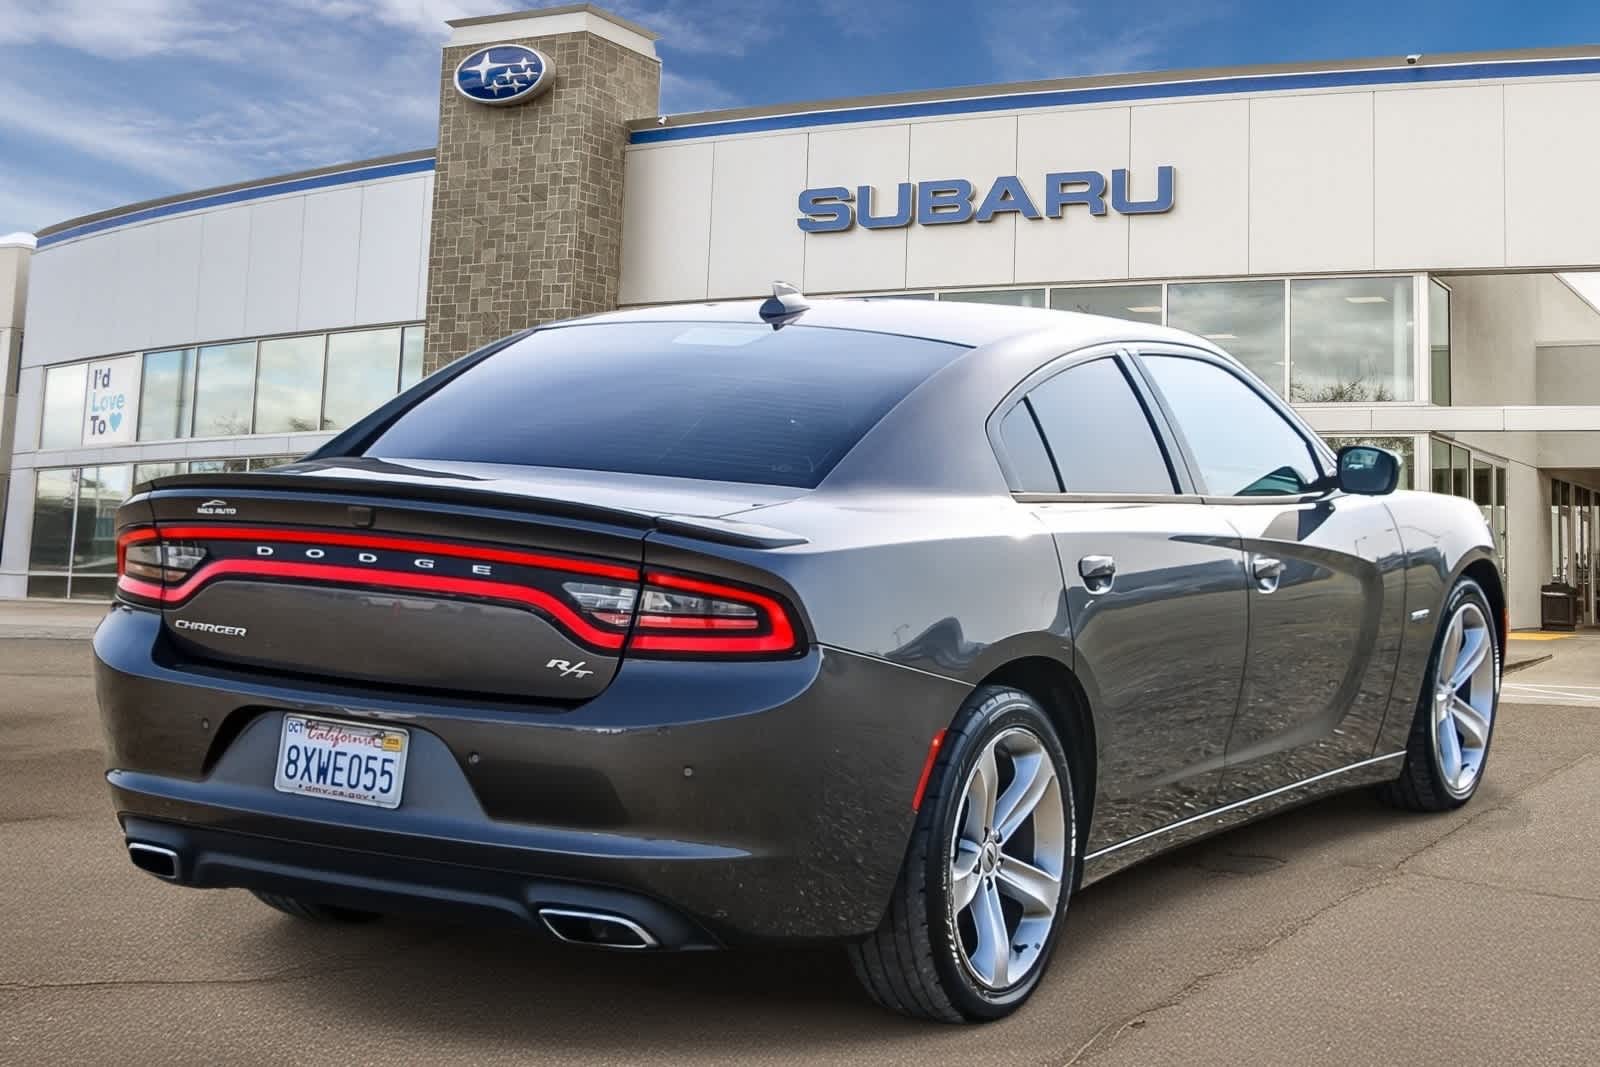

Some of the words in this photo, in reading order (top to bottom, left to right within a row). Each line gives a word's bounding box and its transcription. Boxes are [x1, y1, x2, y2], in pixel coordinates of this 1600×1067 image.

[797, 165, 1175, 233] SUBARU
[94, 368, 111, 389] I'd
[91, 391, 125, 412] Love
[90, 415, 106, 435] To
[256, 546, 492, 575] DODGE
[175, 620, 247, 637] CHARGER
[546, 659, 594, 678] R/T
[288, 721, 304, 733] OCT
[308, 722, 384, 748] California
[284, 745, 394, 794] 8XWE055
